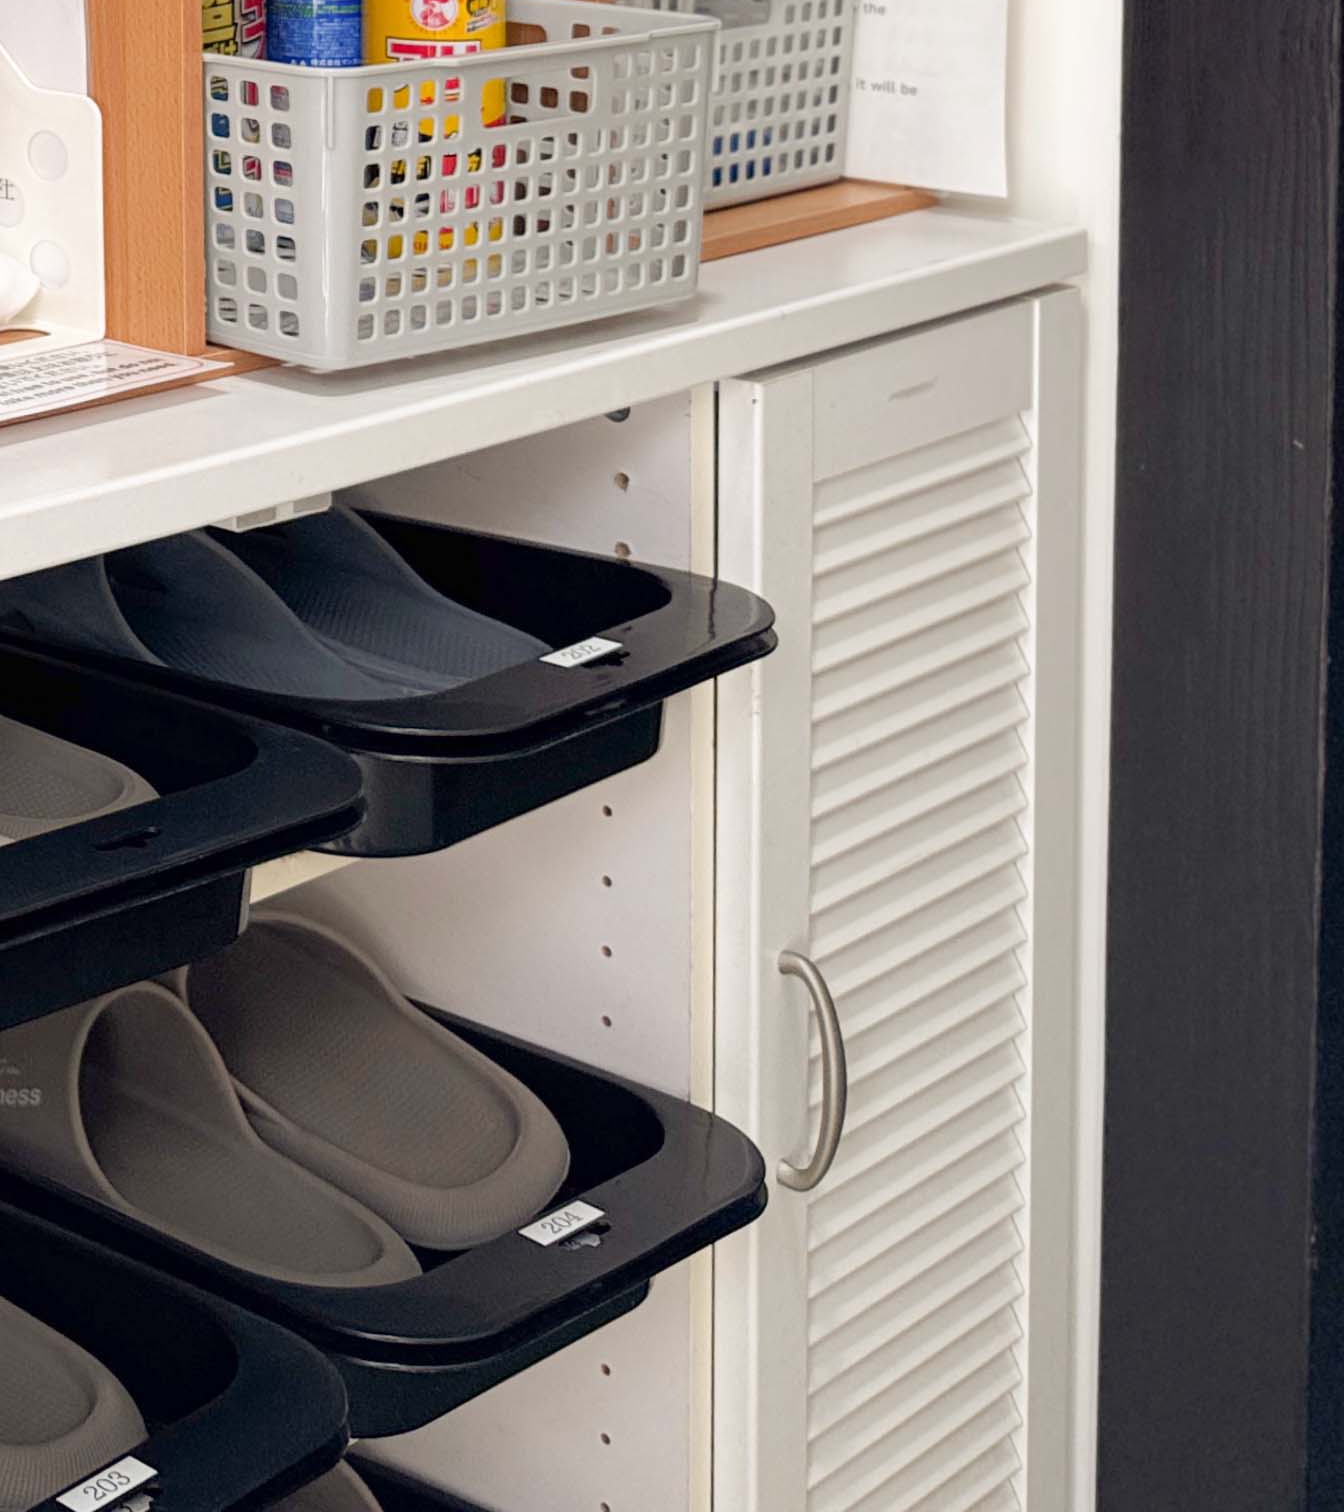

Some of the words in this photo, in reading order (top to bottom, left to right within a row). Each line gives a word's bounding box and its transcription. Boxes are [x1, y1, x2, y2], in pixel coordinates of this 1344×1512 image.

[863, 2, 887, 16] the
[856, 78, 867, 91] it
[871, 80, 895, 94] will
[900, 82, 918, 97] be
[540, 1210, 584, 1234] 204
[82, 1470, 131, 1501] 203
